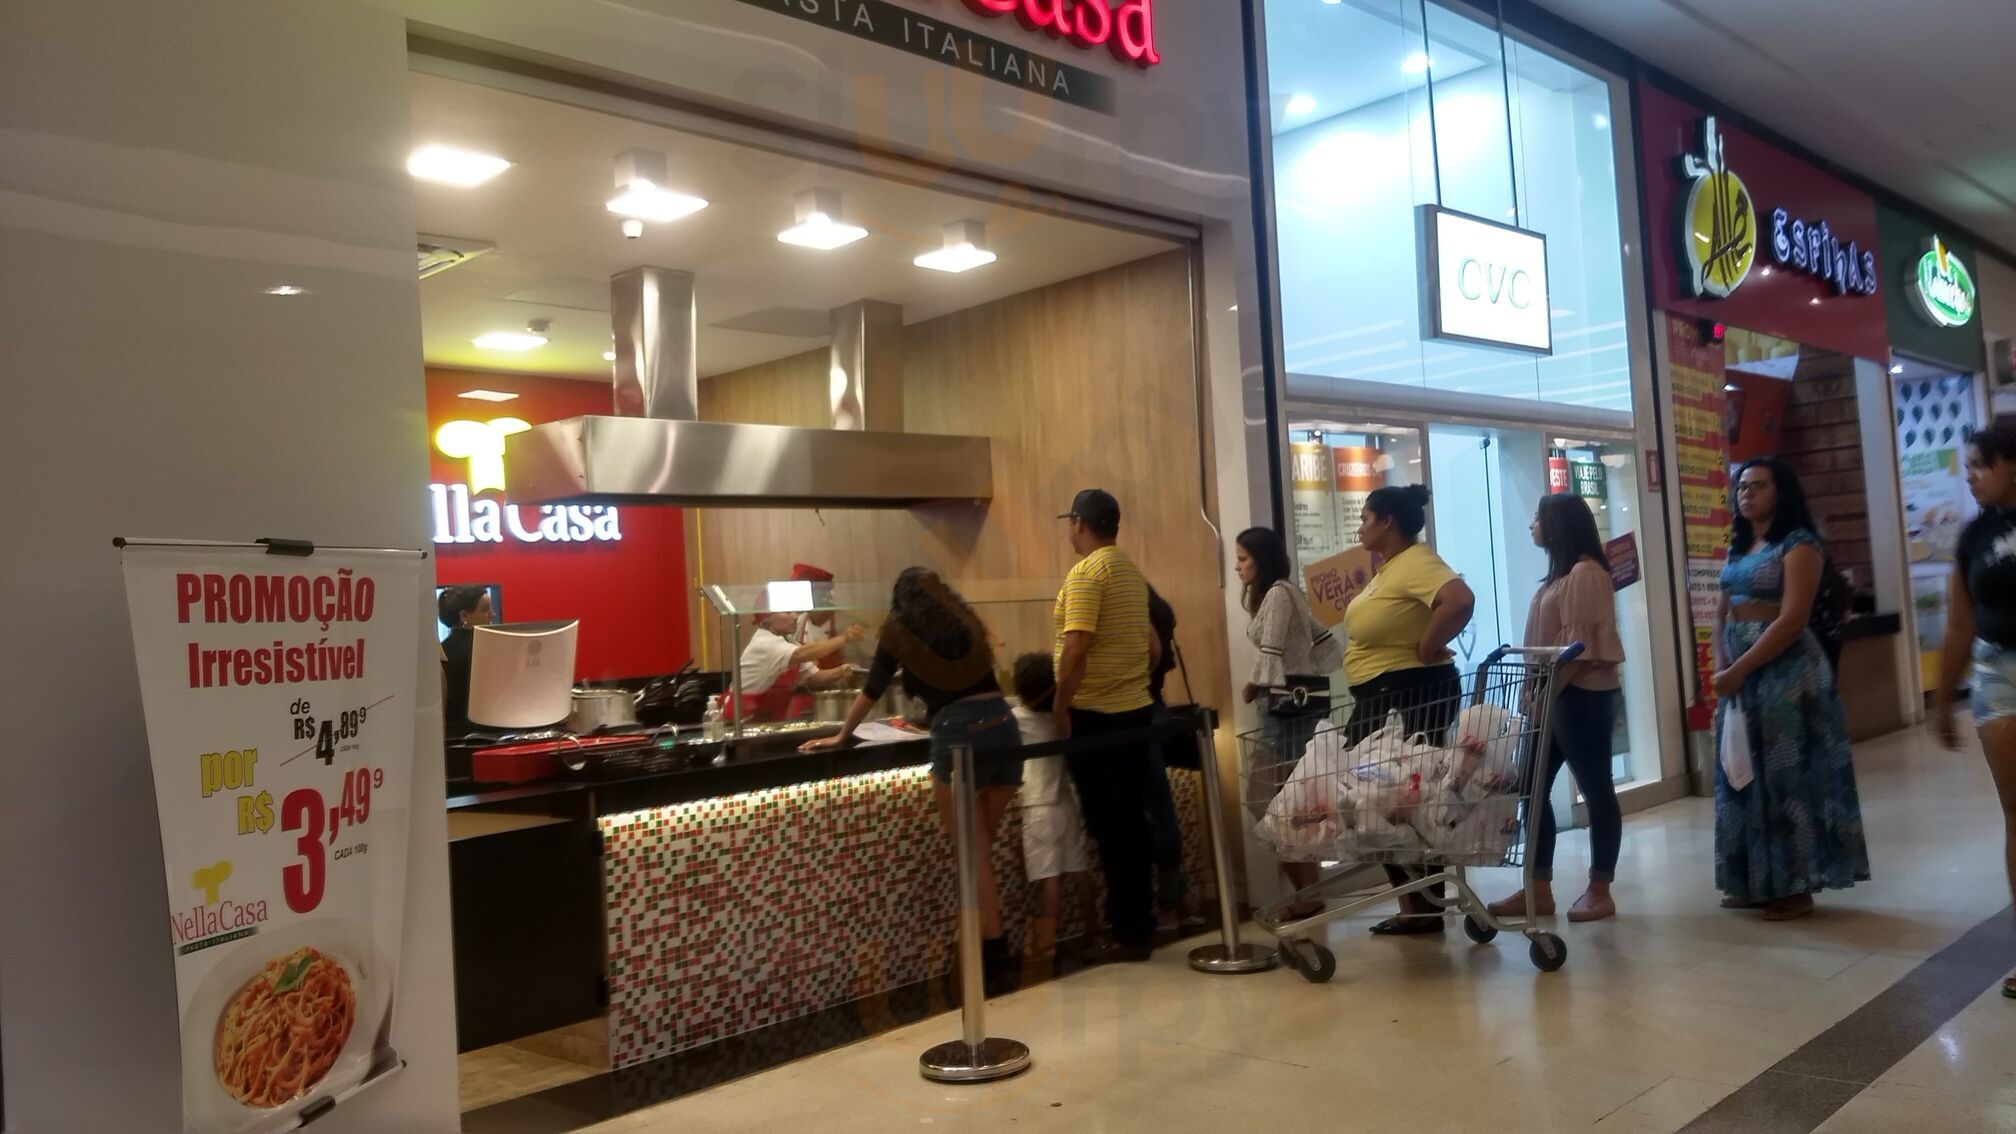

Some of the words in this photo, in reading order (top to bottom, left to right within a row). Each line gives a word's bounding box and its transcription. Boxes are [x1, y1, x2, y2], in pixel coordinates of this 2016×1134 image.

[783, 0, 875, 32] STA
[904, 17, 1070, 96] ITALIANA
[1458, 257, 1531, 309] CVC
[1291, 453, 1327, 481] ARIBE
[1574, 465, 1589, 480] VIAJE
[1310, 568, 1337, 585] PROMO
[176, 568, 375, 631] PROMOÇÃO
[188, 638, 365, 689] Irresistível
[290, 698, 311, 715] de
[294, 716, 316, 740] R$
[200, 746, 258, 799] por
[237, 789, 276, 837] R$
[334, 847, 353, 861] CADA
